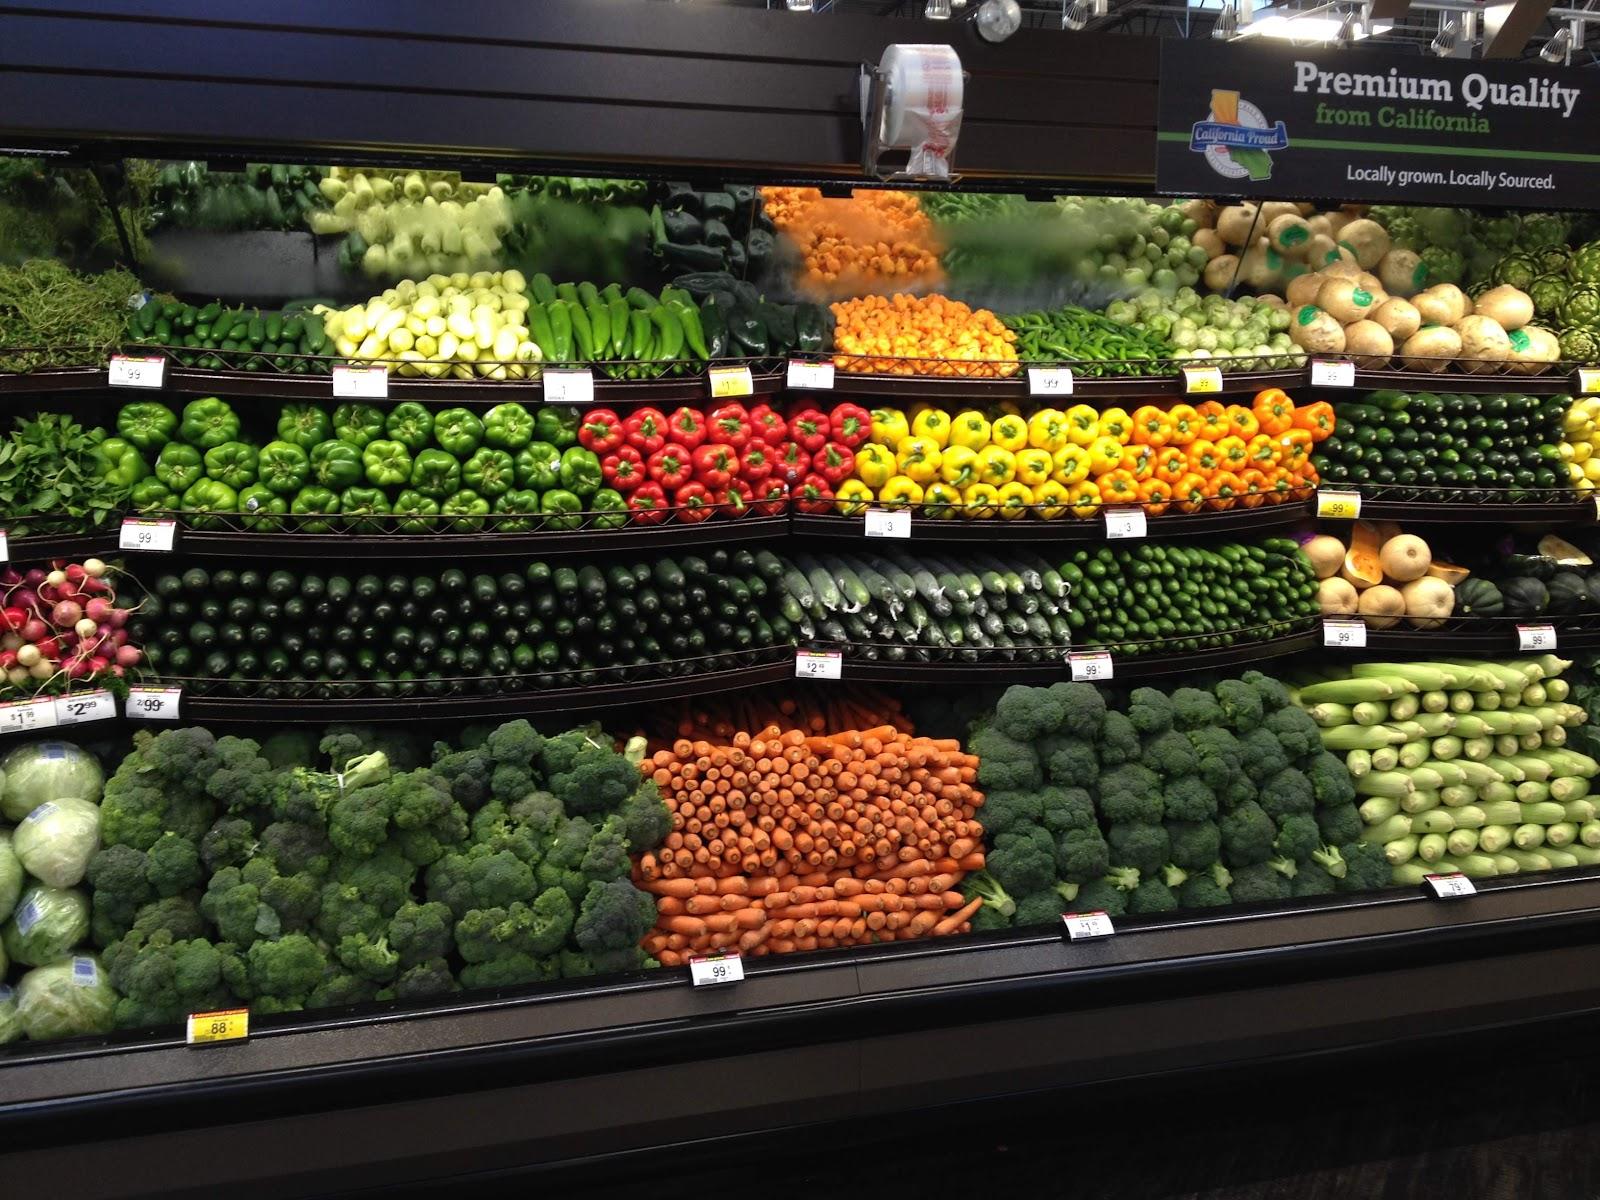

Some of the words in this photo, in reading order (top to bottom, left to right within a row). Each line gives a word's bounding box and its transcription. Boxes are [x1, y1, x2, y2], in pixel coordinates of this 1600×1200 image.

[1294, 60, 1453, 102] Premium
[1461, 73, 1580, 118] Quality
[1315, 102, 1372, 126] from
[1378, 106, 1490, 133] California
[1195, 127, 1245, 143] California
[1246, 130, 1279, 145] Proud
[1347, 165, 1395, 187] Locally
[1399, 169, 1447, 187] grown.
[1450, 170, 1496, 190] Locally
[1498, 172, 1556, 190] Sourced.
